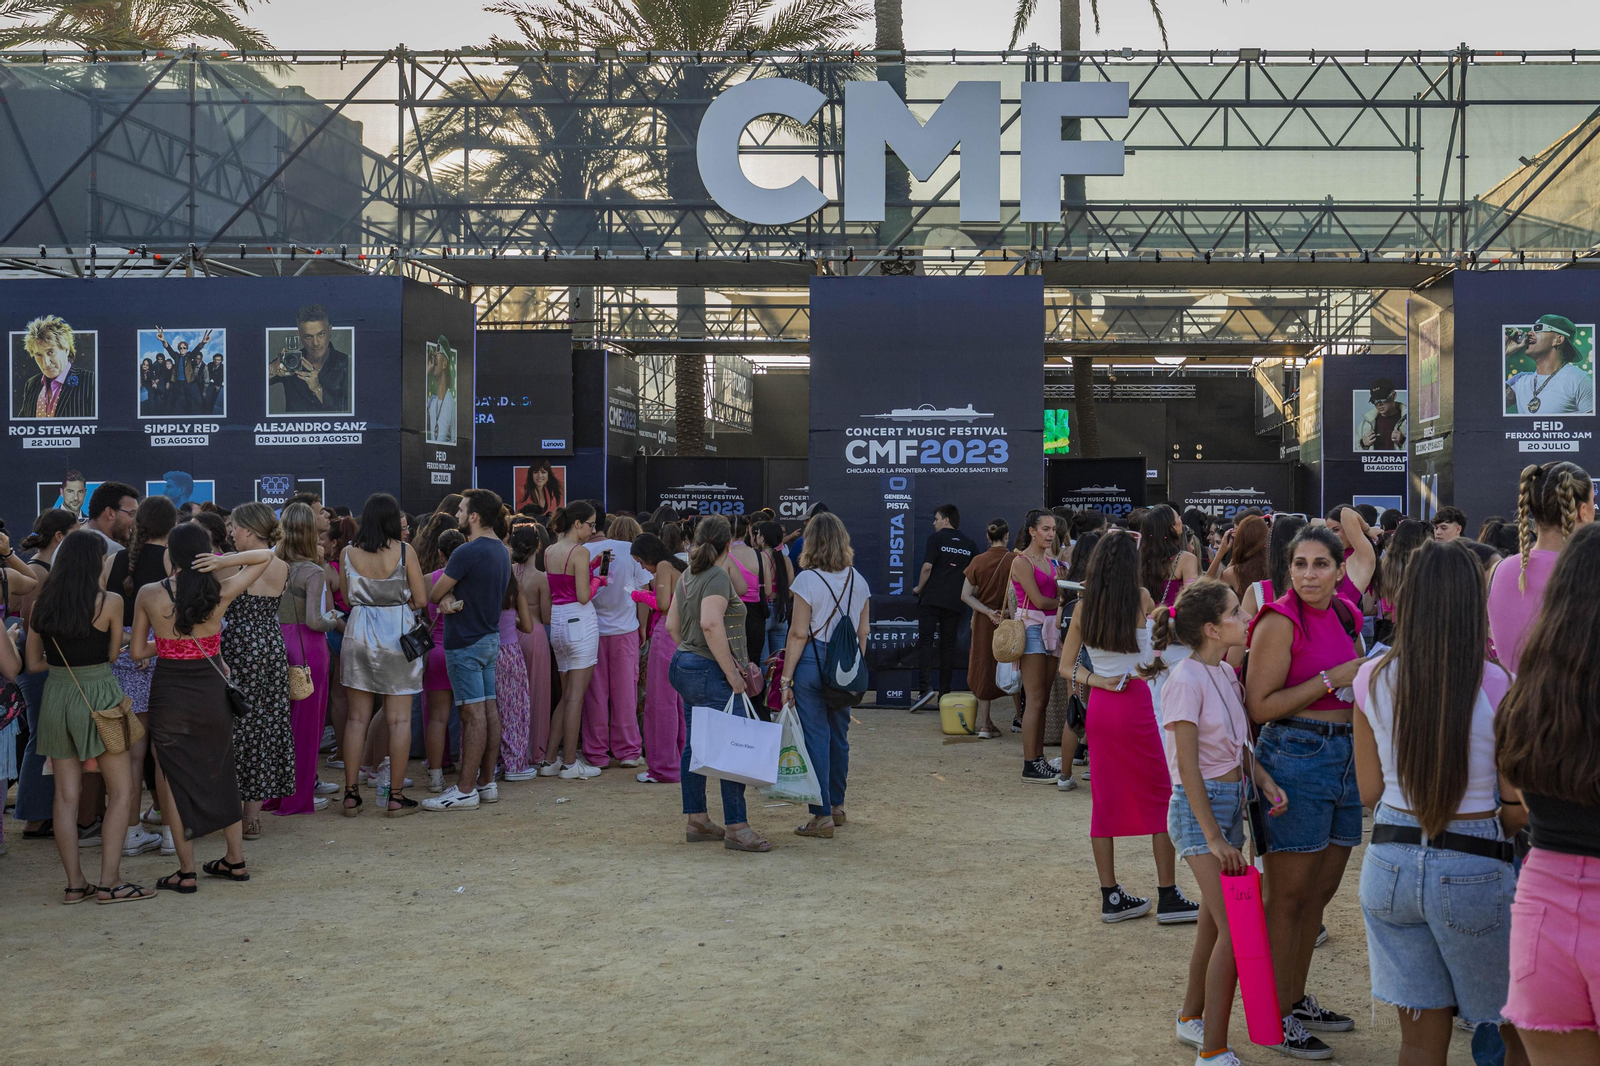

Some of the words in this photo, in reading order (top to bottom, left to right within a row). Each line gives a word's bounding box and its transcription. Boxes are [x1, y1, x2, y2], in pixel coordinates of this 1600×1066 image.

[696, 77, 1130, 225] CMF
[609, 405, 637, 430] CMF2023
[8, 426, 36, 436] ROD
[38, 425, 98, 435] STEWART
[144, 423, 191, 433] SIMPLY
[193, 423, 220, 433] RED
[253, 422, 332, 432] ALEJANDRO
[333, 421, 367, 431] SANZ
[1533, 421, 1564, 431] FEID
[845, 427, 904, 437] CONCERT
[907, 427, 946, 436] MUSIC
[949, 426, 1008, 436] FESTIVAL
[1571, 431, 1592, 439] JAM
[31, 439, 43, 447] 22
[154, 437, 166, 445] 05
[167, 436, 206, 444] AGOSTO
[308, 435, 321, 443] 03
[435, 450, 447, 461] FEID
[845, 438, 1009, 465] CMF2023
[1361, 455, 1408, 463] BIZARRAP
[886, 502, 910, 510] PISTA
[1062, 503, 1132, 518] MF2023
[889, 513, 905, 567] PISTA
[867, 632, 906, 640] NCERT
